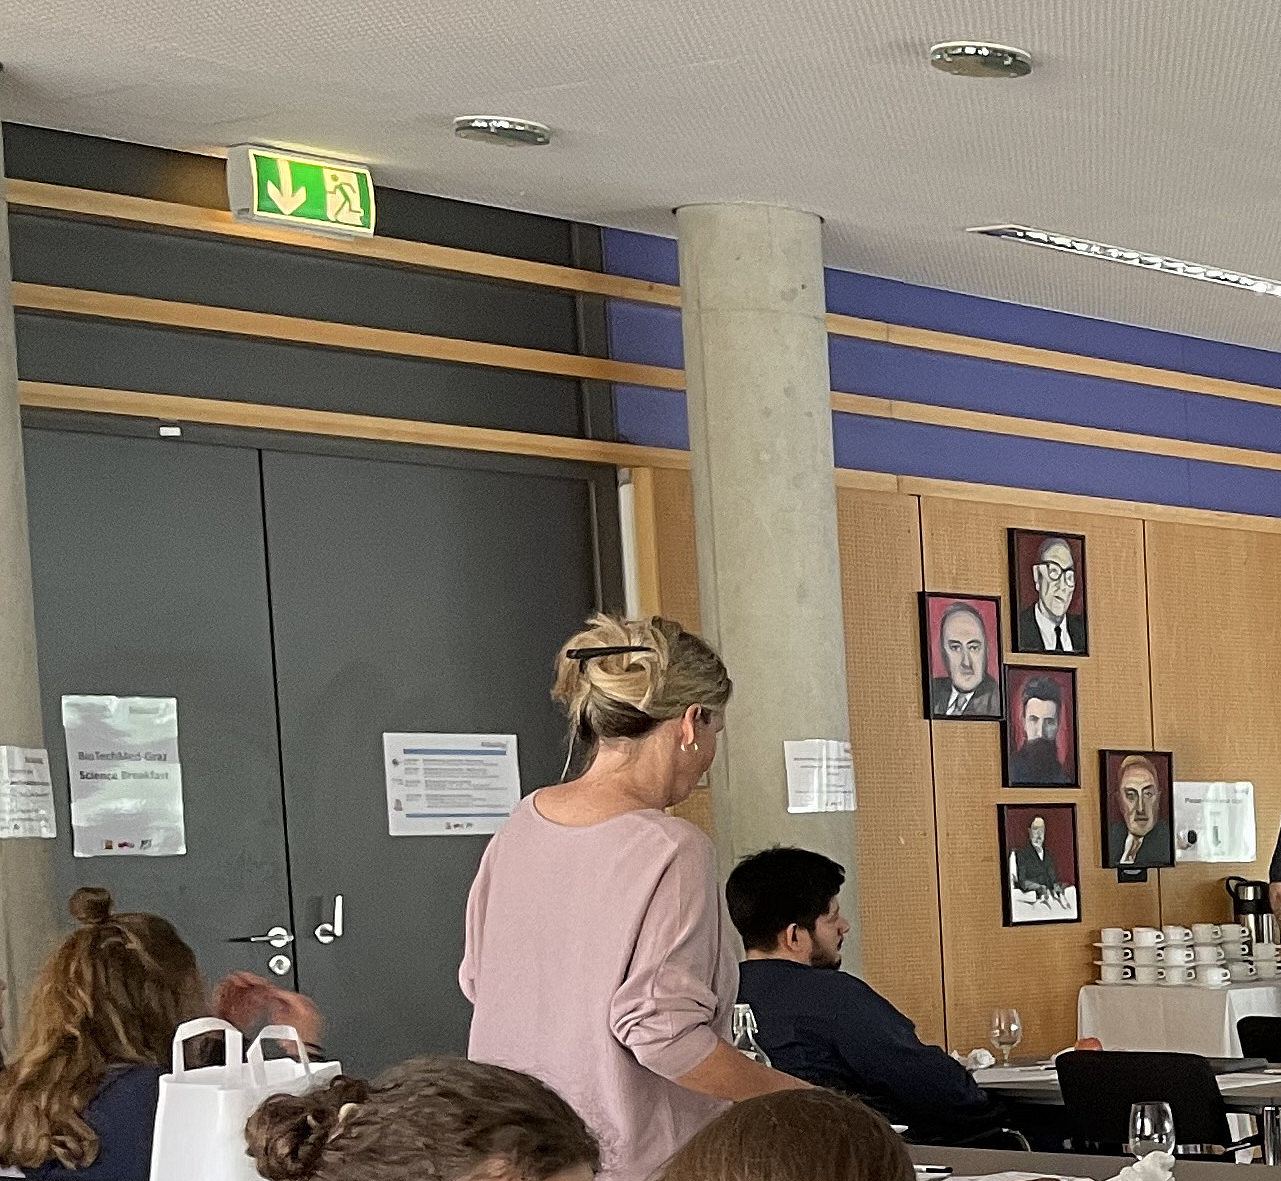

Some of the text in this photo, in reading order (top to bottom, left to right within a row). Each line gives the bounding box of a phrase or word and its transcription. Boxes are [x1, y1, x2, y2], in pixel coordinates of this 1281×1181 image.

[77, 751, 168, 762] BioTechMed-Graz
[79, 770, 169, 780] Science Breakfast
